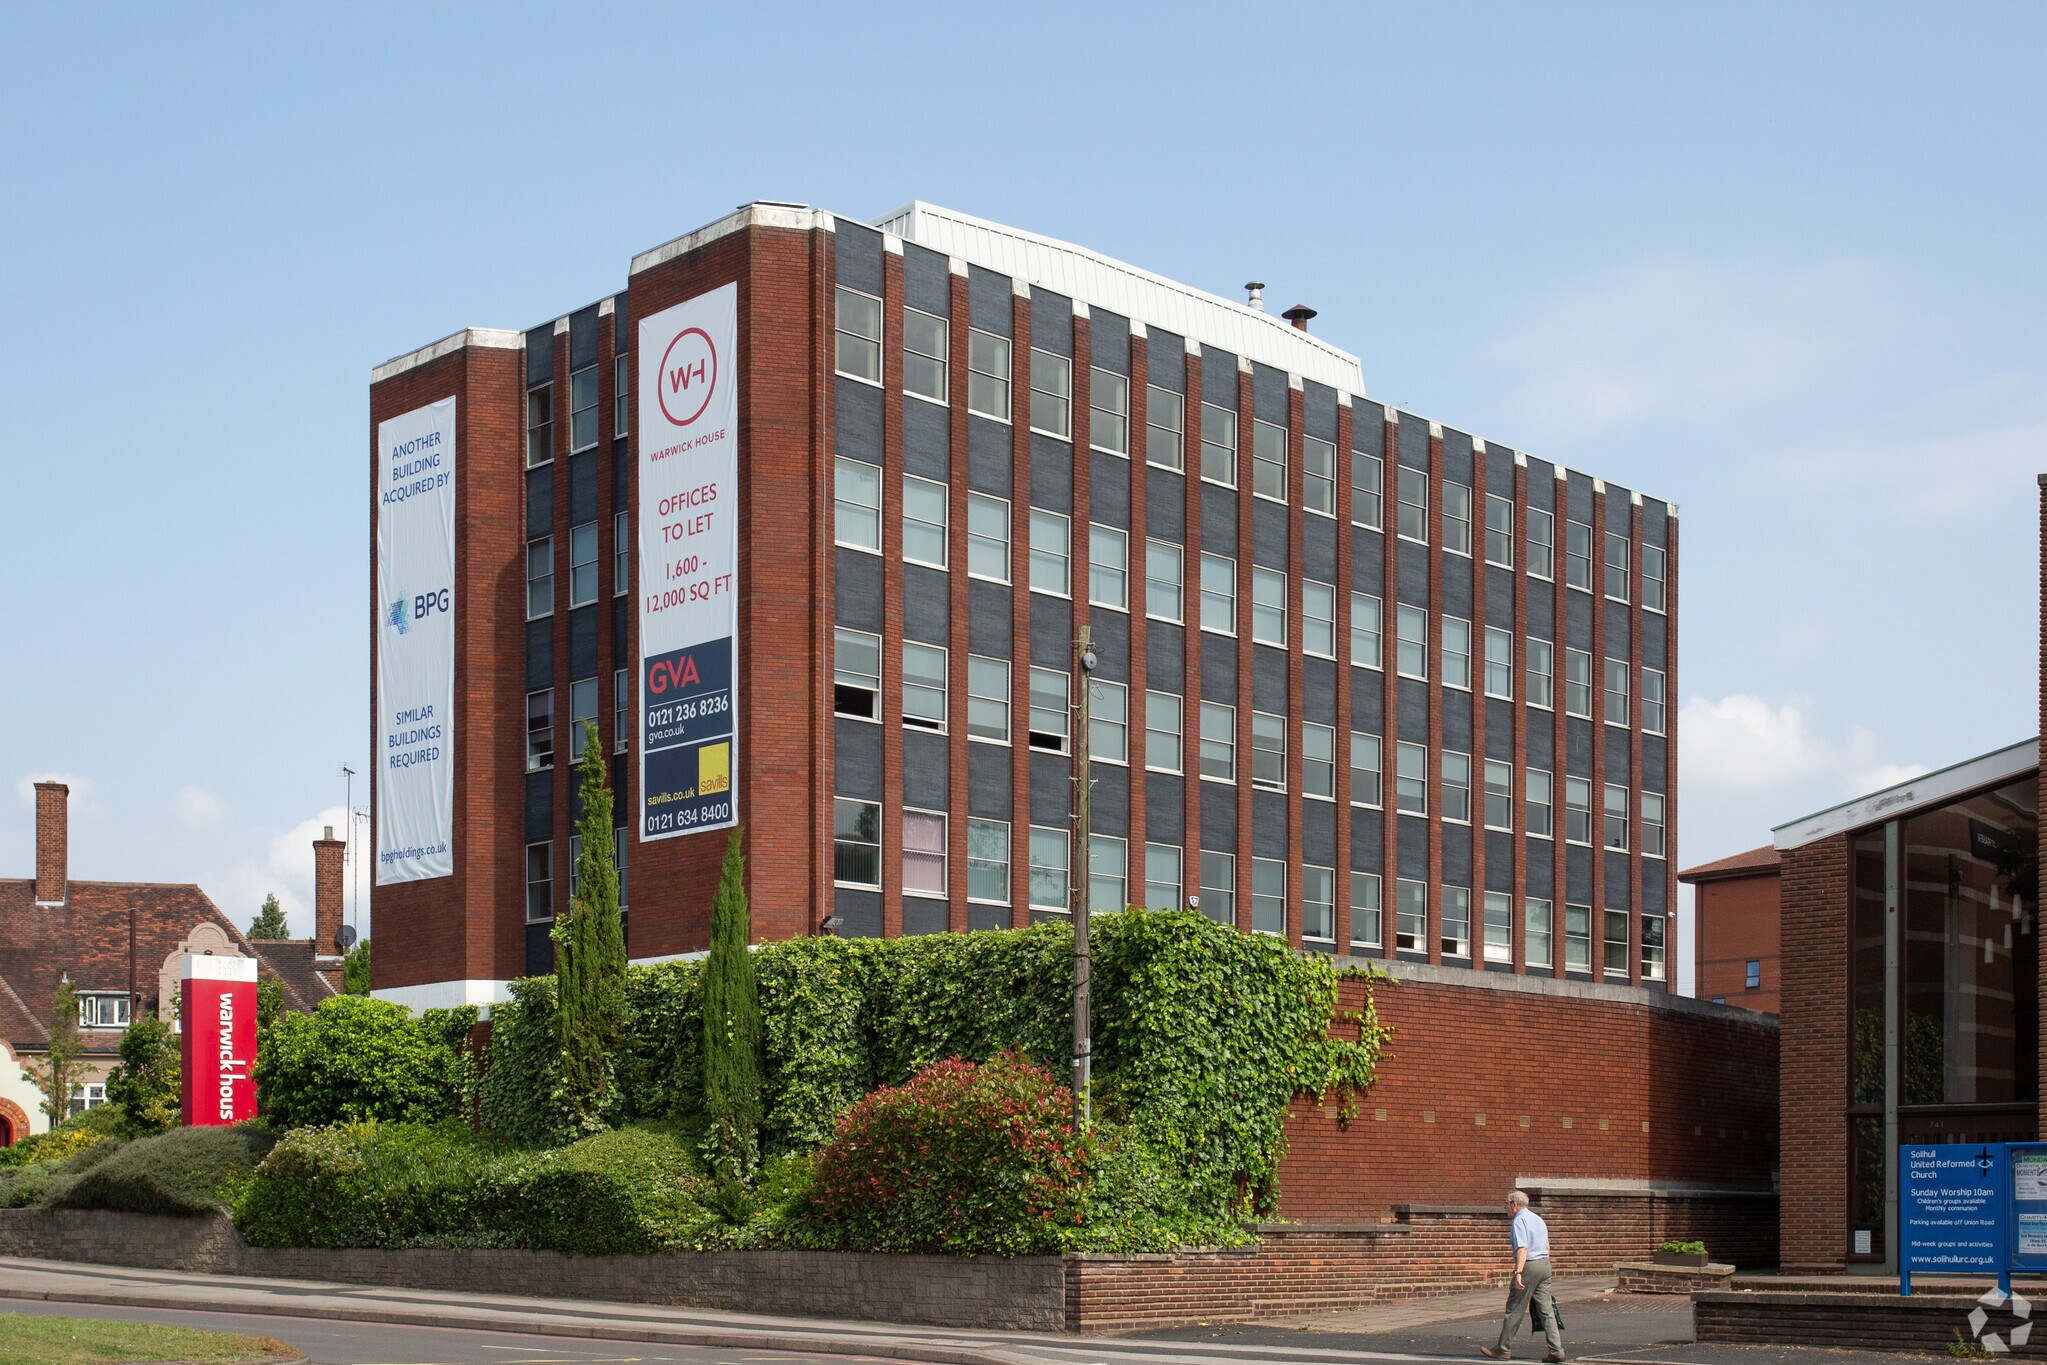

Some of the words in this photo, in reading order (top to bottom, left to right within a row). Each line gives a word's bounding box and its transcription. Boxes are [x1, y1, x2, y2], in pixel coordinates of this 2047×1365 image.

[392, 432, 441, 460] ANOTHER
[650, 440, 692, 462] WARWICK
[696, 429, 725, 447] HOUSE
[393, 454, 440, 481] BUILDING
[382, 478, 434, 505] ACQUIRED
[438, 471, 450, 487] BY
[659, 483, 717, 516] OFFICES
[662, 523, 683, 543] TO
[688, 512, 714, 536] LET
[666, 556, 698, 581] 1,600
[415, 589, 449, 619] BPG
[646, 588, 686, 614] 12,000
[690, 581, 710, 602] SQ
[715, 574, 732, 594] FT
[649, 655, 700, 694] GVA
[396, 705, 433, 725] SIMILAR
[649, 706, 672, 728] 0121
[676, 701, 696, 722] 236
[700, 695, 728, 716] 8236
[389, 725, 441, 748] BUILDINGS
[648, 723, 684, 744] gva.co.uk
[390, 747, 439, 769] REQUIRED
[700, 774, 728, 792] savills
[648, 787, 695, 806] savills.co.uk
[648, 813, 673, 832] 0121
[678, 808, 698, 826] 634
[701, 802, 728, 822] 8400
[381, 841, 447, 863] bpgholdings.co.uk
[220, 993, 246, 1071] warwick
[1911, 1150, 1936, 1158] Solihull
[1911, 1160, 1935, 1168] United
[1911, 1188, 1938, 1197] Sunday
[1941, 1188, 1972, 1197] Worship
[1911, 1255, 1994, 1266] www.solihullurc.org.uk
